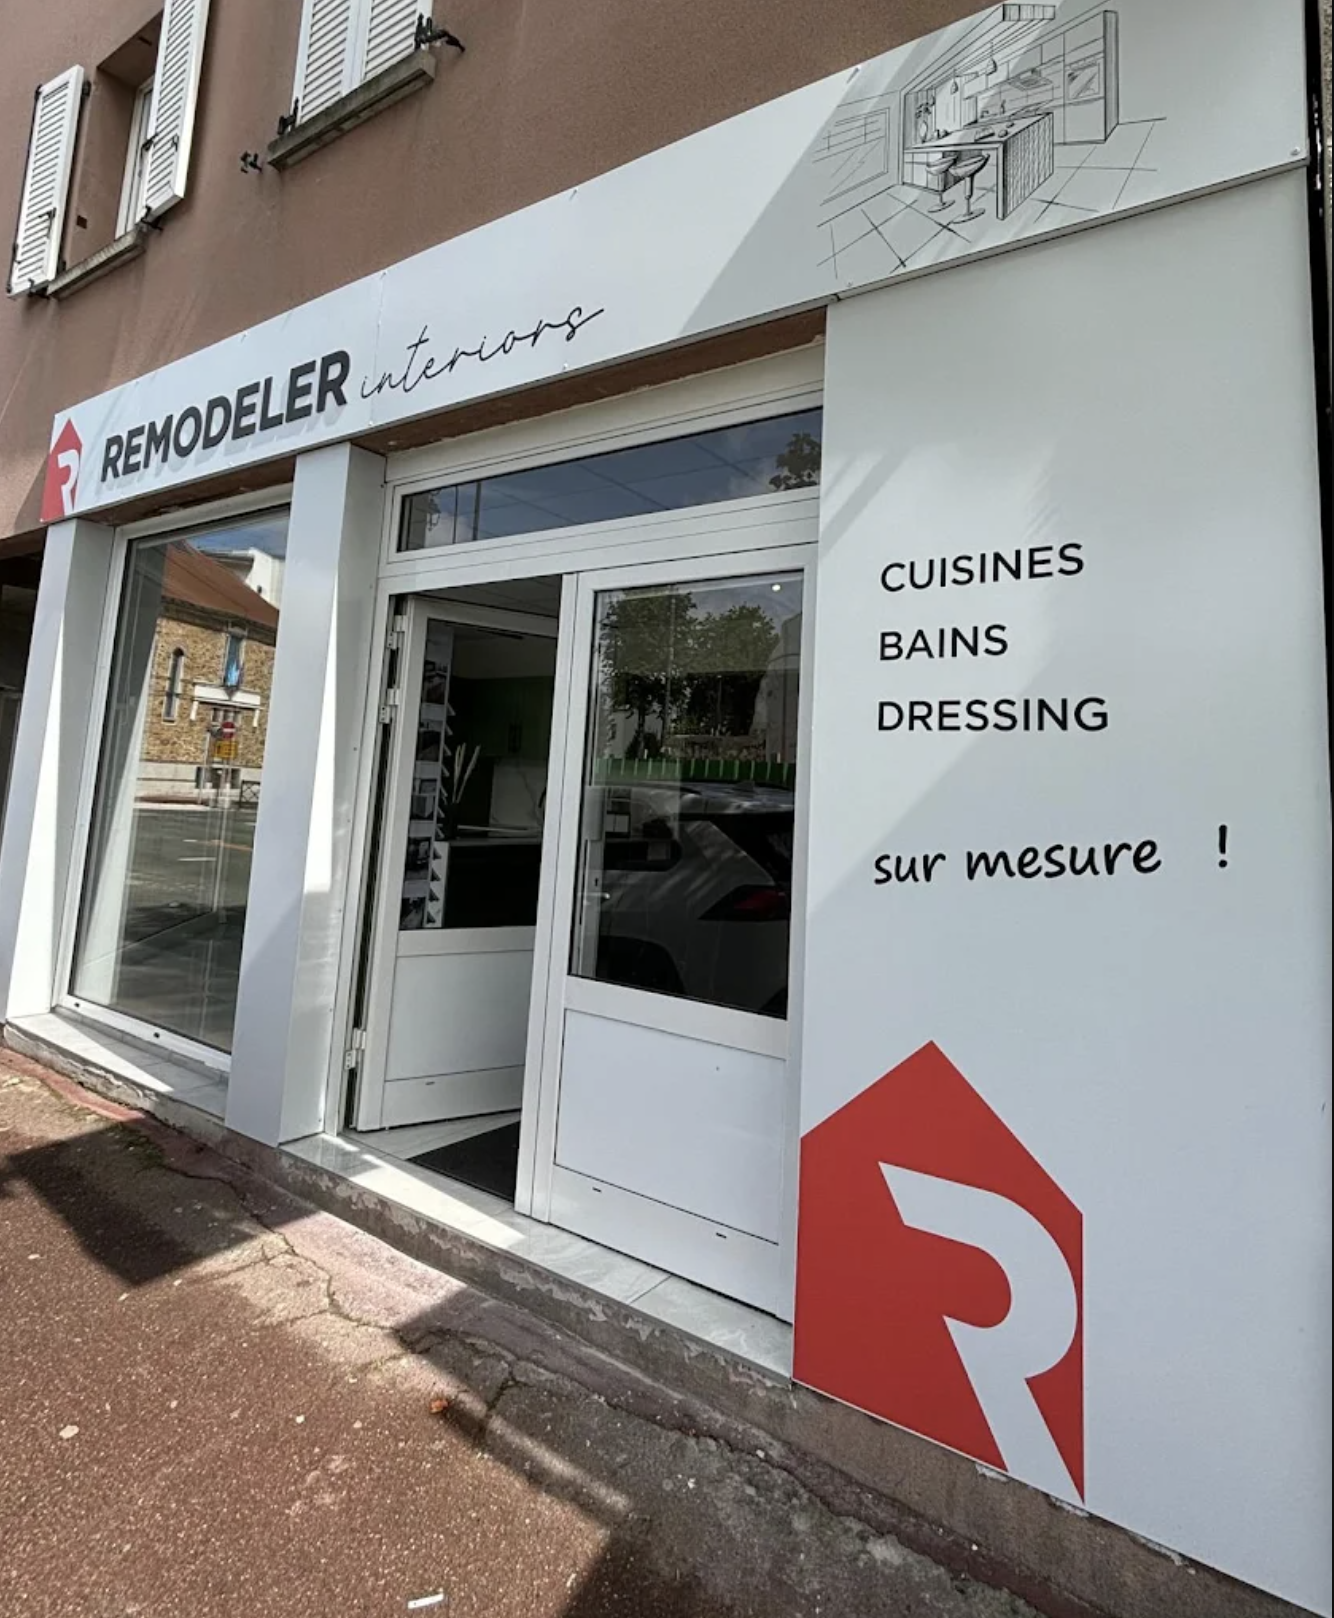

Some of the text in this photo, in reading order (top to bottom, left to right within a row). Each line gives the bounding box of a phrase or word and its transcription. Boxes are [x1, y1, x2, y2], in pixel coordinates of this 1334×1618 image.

[101, 306, 604, 482] REMODELER interiors
[57, 448, 80, 516] R
[880, 542, 1085, 593] CUISINES
[879, 623, 1009, 662] BAINS
[877, 696, 1109, 732] DRESSING
[873, 824, 1230, 886] sur mesure !
[878, 1161, 1084, 1504] R
